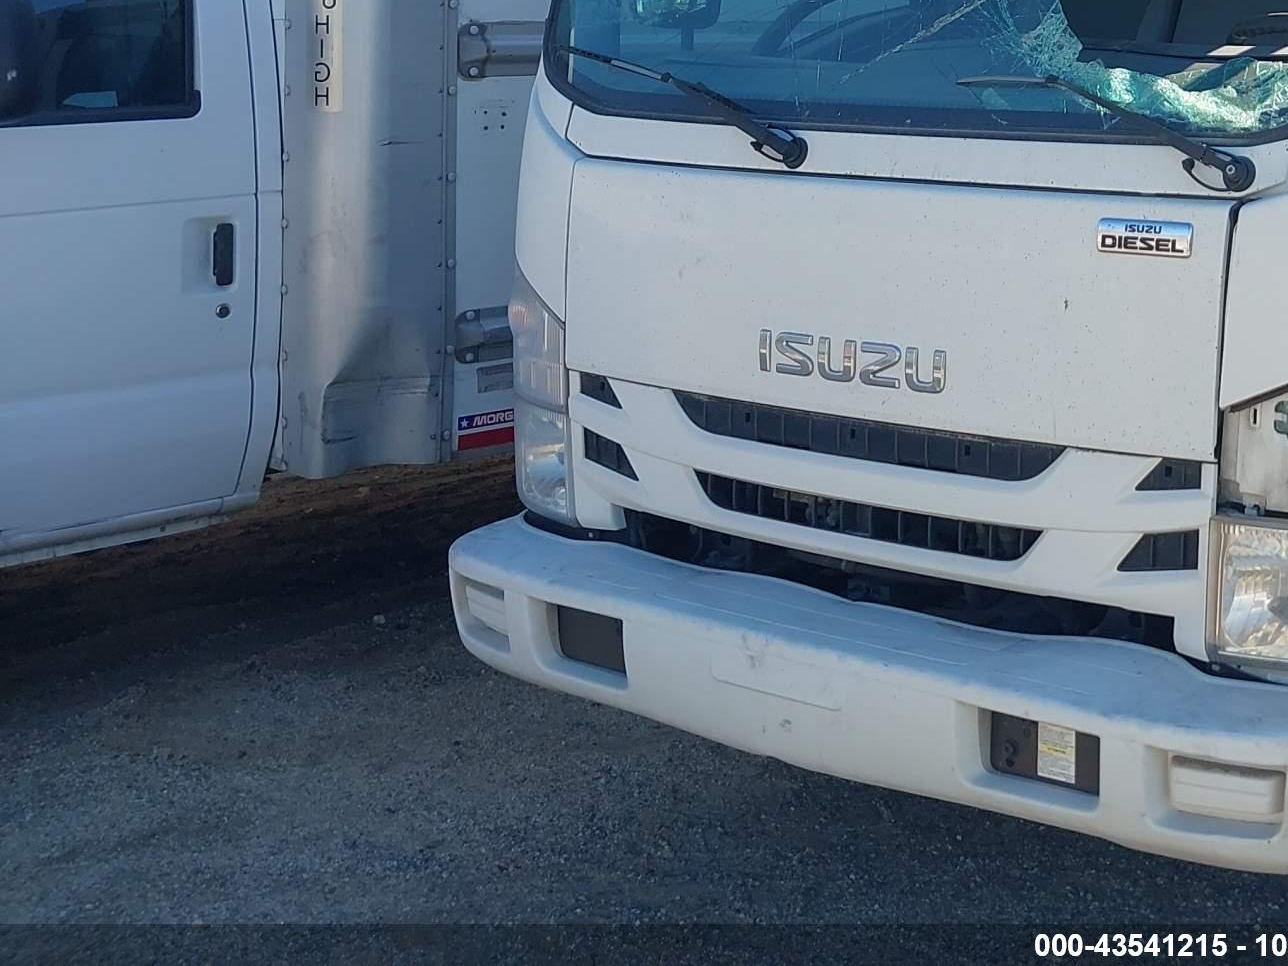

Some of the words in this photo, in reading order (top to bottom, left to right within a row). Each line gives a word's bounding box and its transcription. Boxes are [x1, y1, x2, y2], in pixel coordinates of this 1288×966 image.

[1124, 224, 1162, 235] ISUZU
[1100, 234, 1185, 253] DIESEL
[759, 328, 947, 394] ISUZU
[472, 411, 513, 427] MORG
